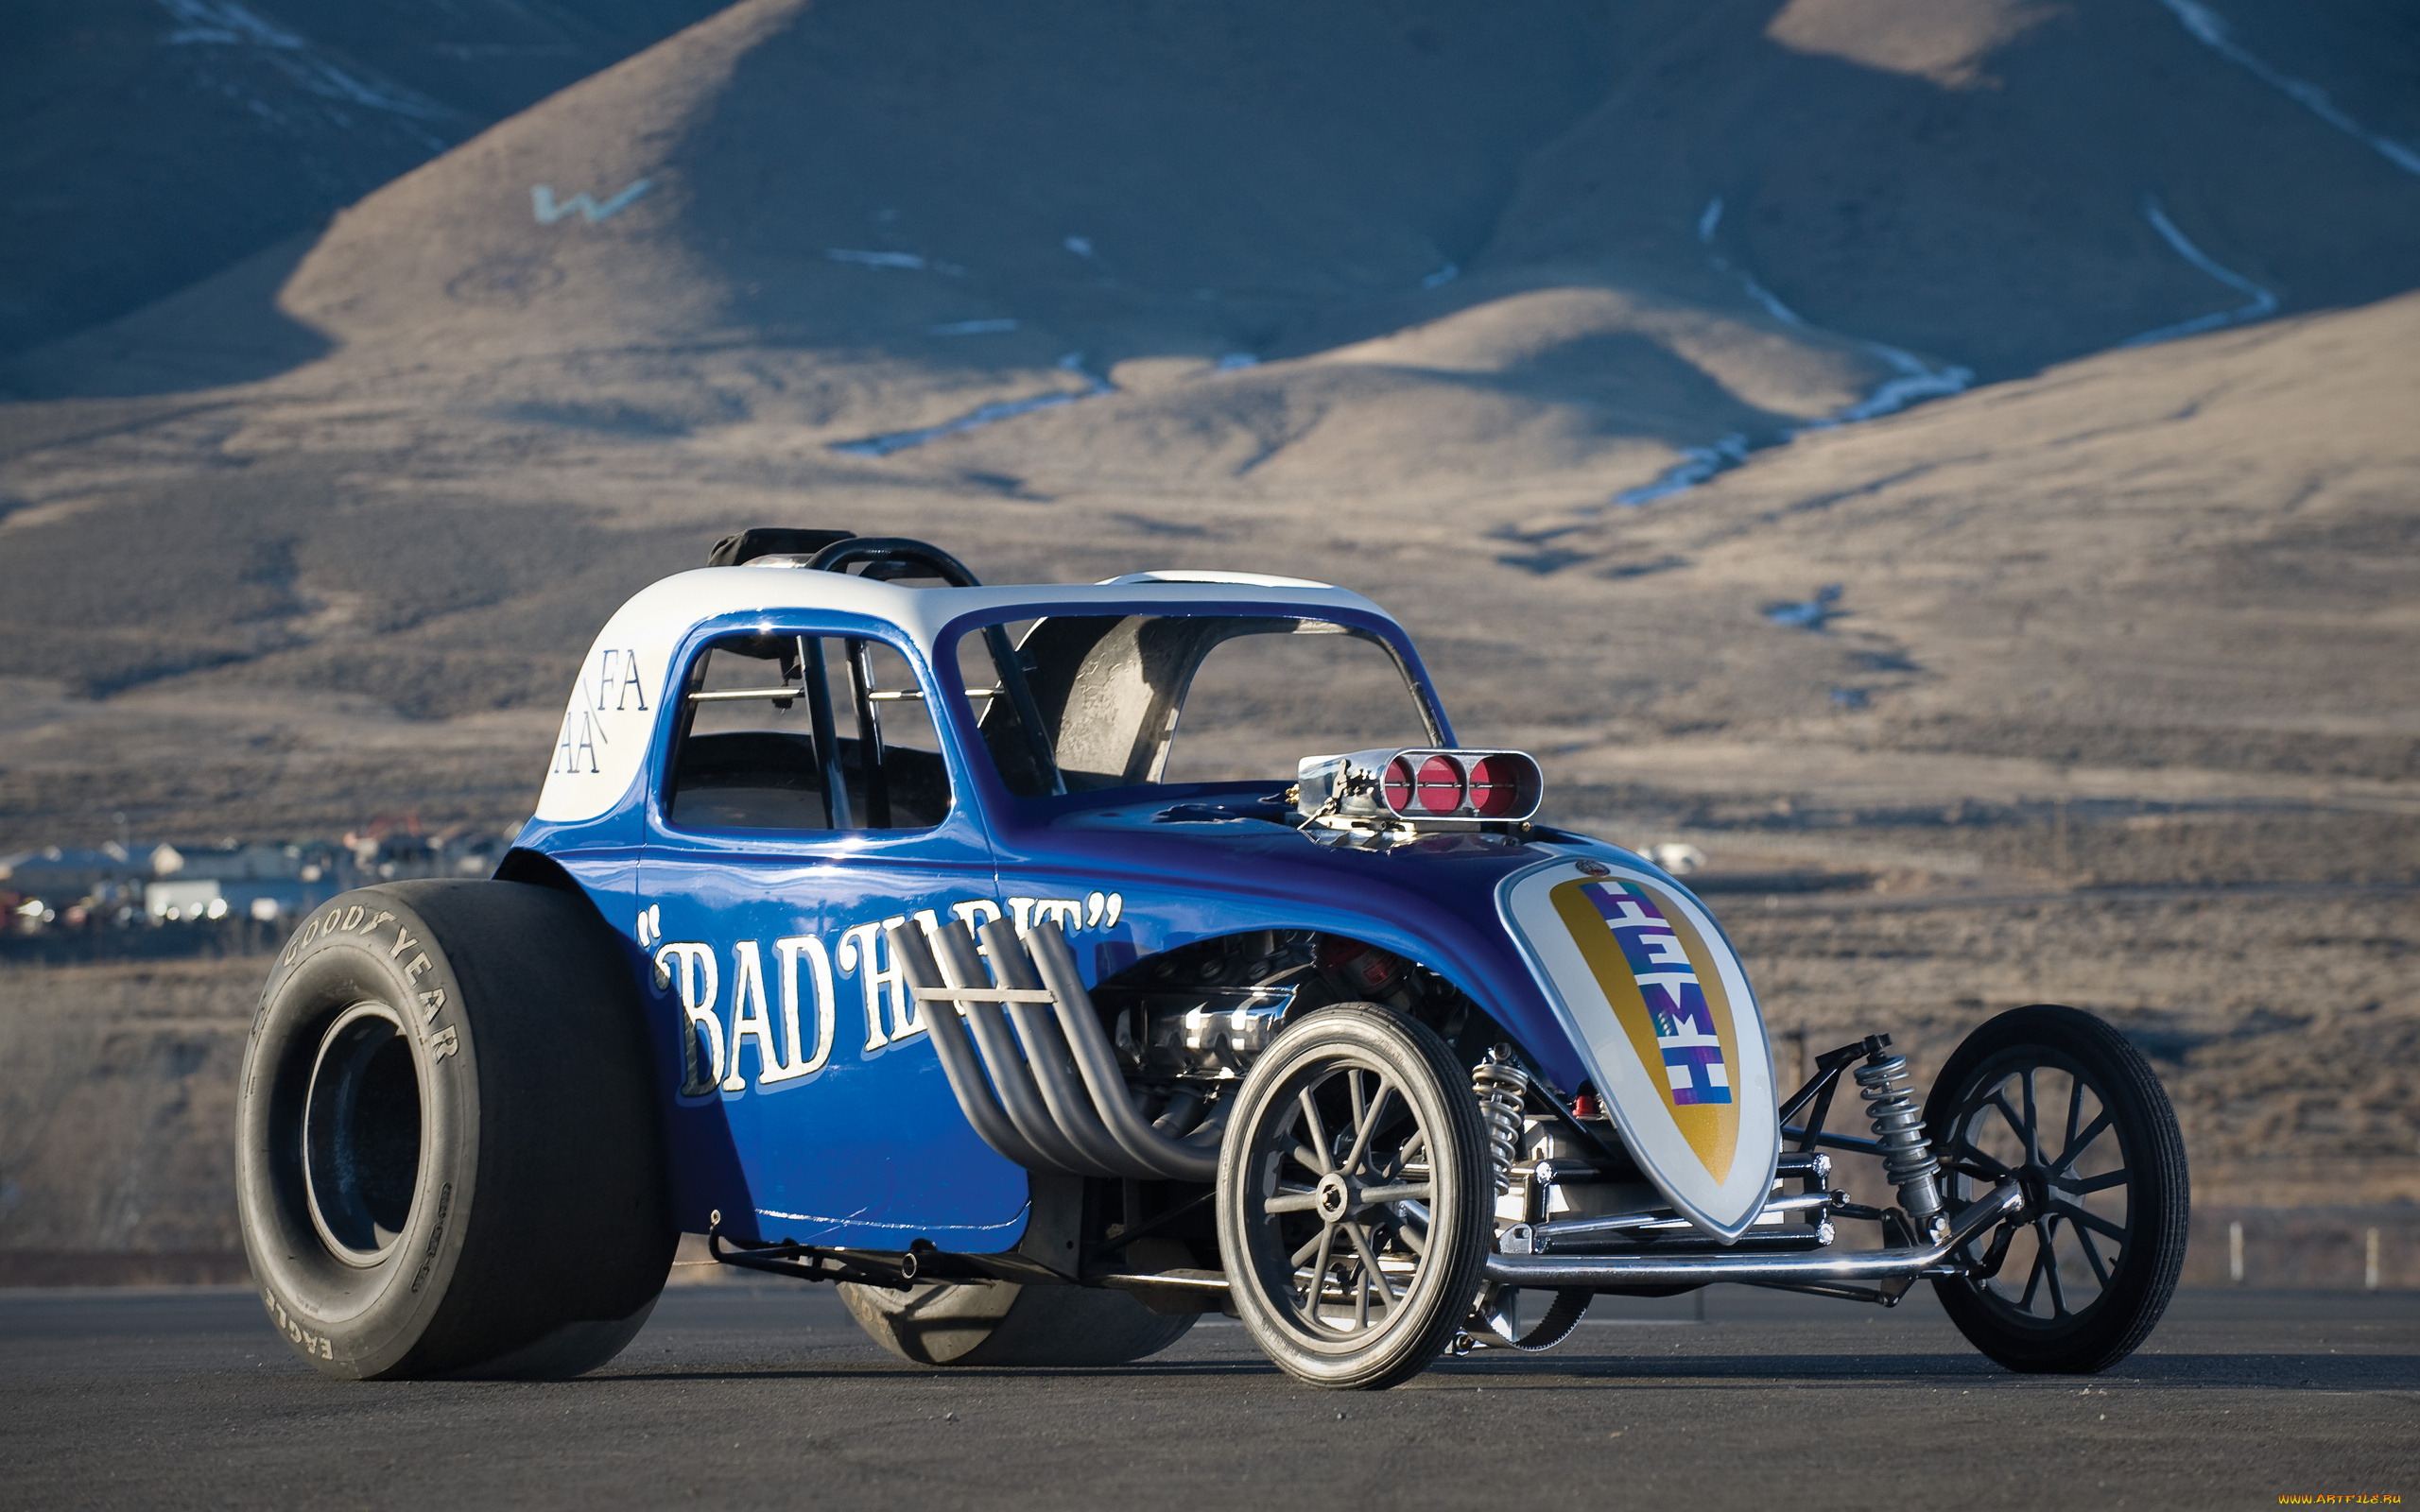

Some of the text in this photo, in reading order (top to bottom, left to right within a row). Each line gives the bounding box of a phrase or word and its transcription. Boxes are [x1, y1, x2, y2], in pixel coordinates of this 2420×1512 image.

[597, 648, 648, 711] FA
[554, 711, 599, 773] AA
[1578, 881, 1733, 1106] HEMI
[266, 1286, 334, 1361] EAGLE
